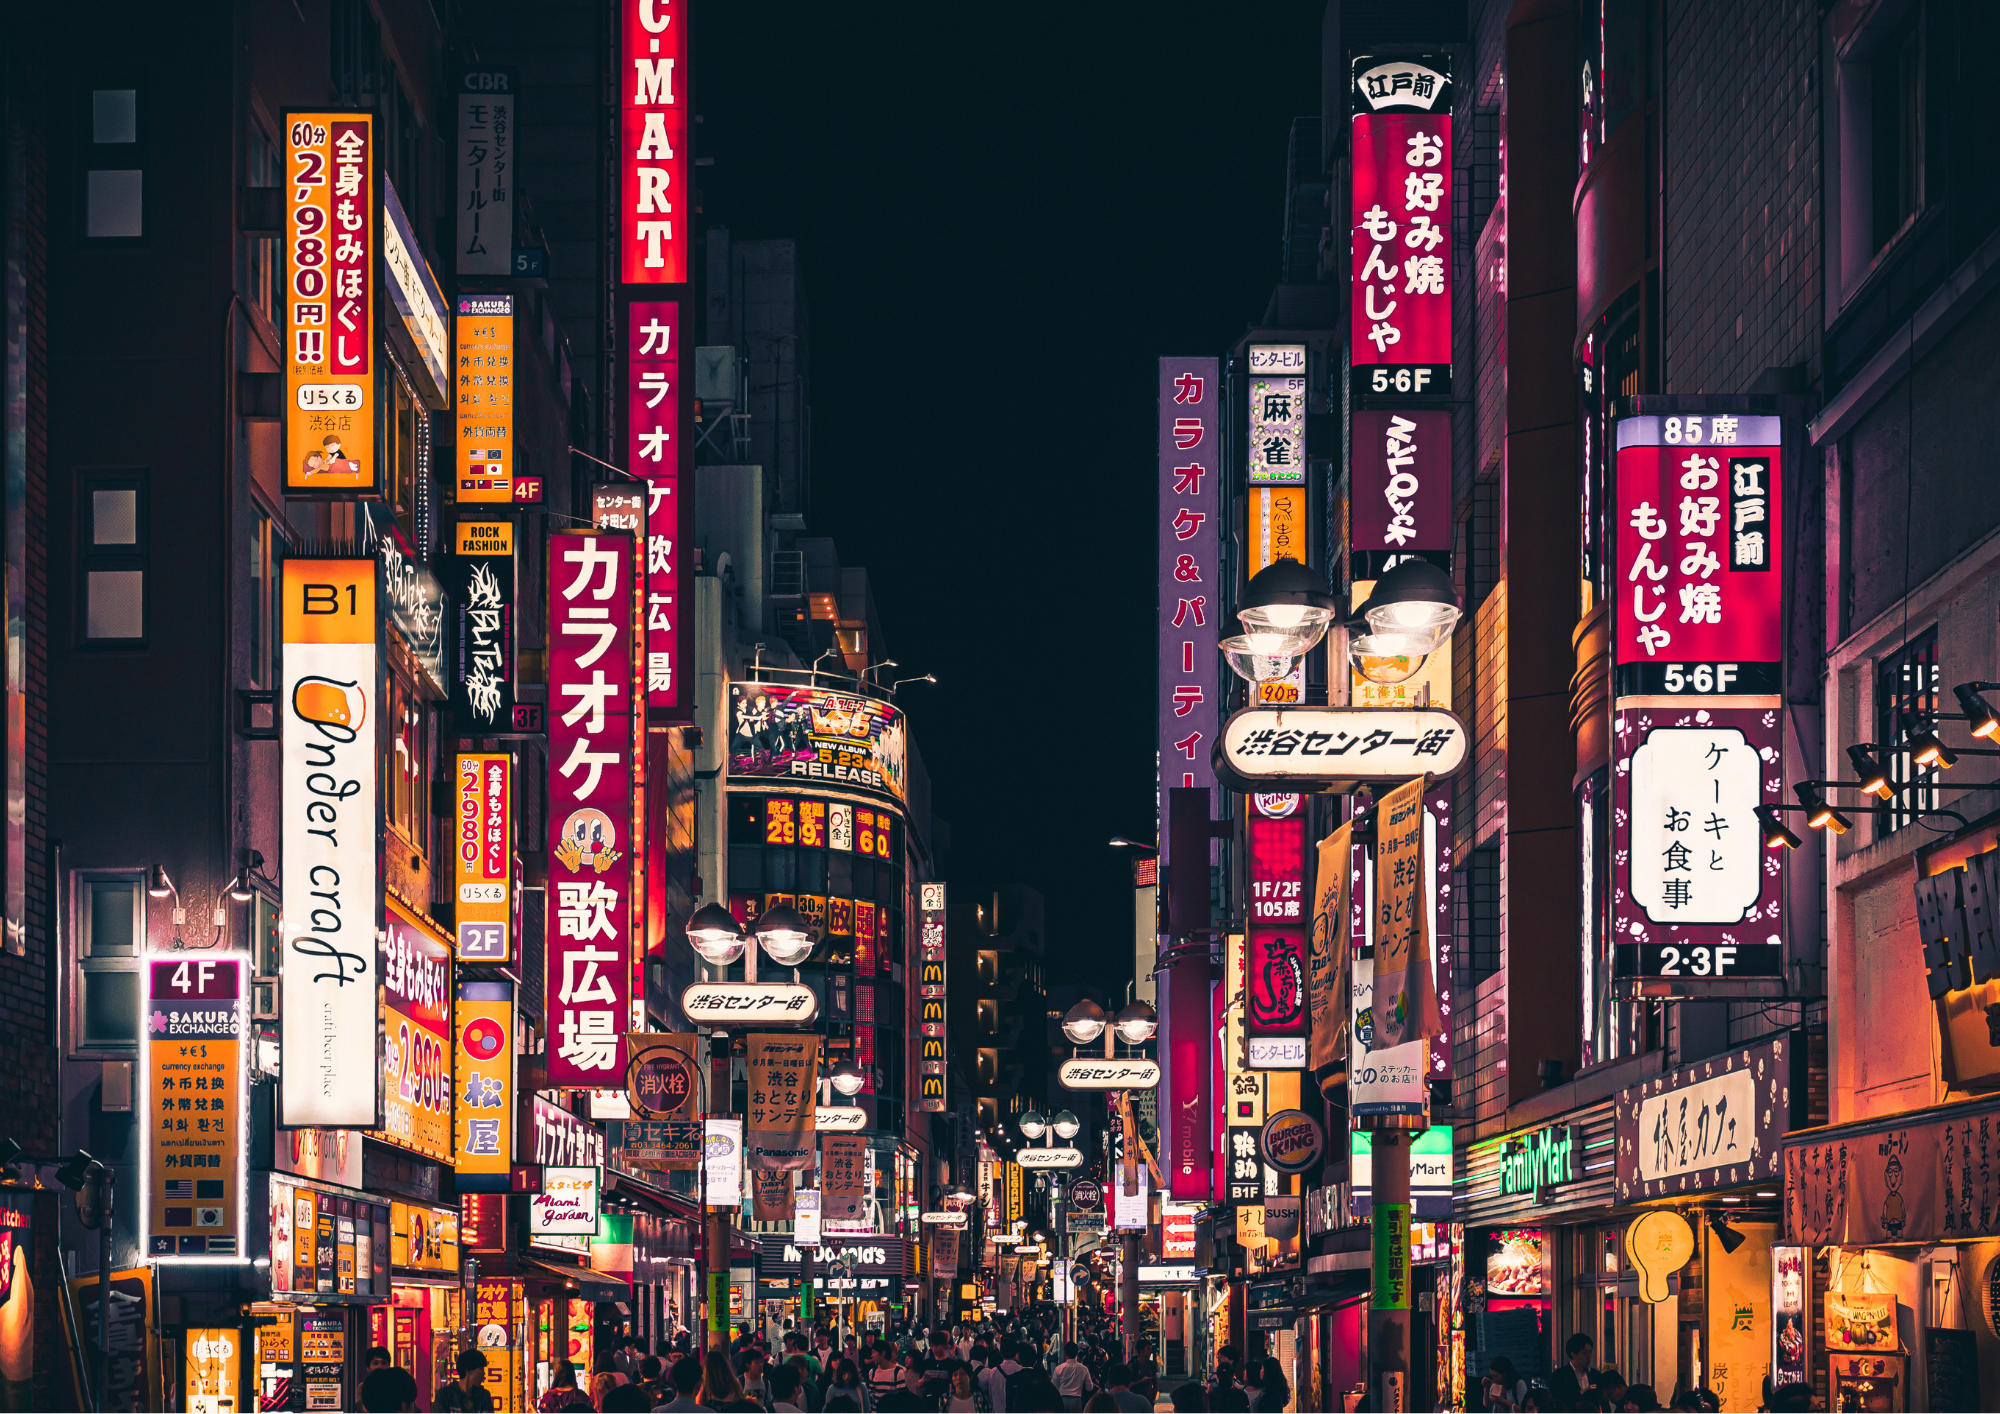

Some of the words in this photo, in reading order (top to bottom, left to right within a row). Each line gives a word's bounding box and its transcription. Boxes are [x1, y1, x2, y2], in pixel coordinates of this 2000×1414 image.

[464, 72, 508, 90] CBR
[1366, 73, 1435, 98] 江戸前
[492, 105, 507, 202] 渋谷センター街
[466, 105, 488, 255] モニタールーム
[1403, 131, 1445, 295] お好み焼
[334, 129, 365, 366] 全身もみほぐし
[1360, 205, 1401, 353] もんじゃ
[471, 301, 510, 312] SAKURA
[1251, 351, 1303, 367] センタービル
[1289, 379, 1304, 390] 5F
[303, 391, 361, 406] りらくる
[309, 415, 351, 431] 渋谷店
[463, 426, 507, 437] 外貨両替
[1263, 394, 1291, 465] 麻雀
[1664, 415, 1738, 444] 85席
[515, 483, 539, 498] 4F
[597, 495, 641, 510] センター街
[1733, 462, 1764, 565] 江戸前
[471, 526, 499, 537] ROCK
[1679, 453, 1721, 624] お好み焼
[463, 540, 507, 551] FASHION
[1628, 501, 1671, 656] もんじゃ
[303, 584, 357, 615] B1
[1362, 686, 1406, 698] 北海道
[517, 708, 538, 727] 3F
[815, 742, 837, 751] NEW
[838, 744, 867, 755] ALBUM
[1236, 729, 1455, 756] 渋谷センター街
[819, 749, 863, 768] 5.23
[791, 761, 882, 787] RELEASE
[558, 537, 620, 1071] カラオケ歌広場
[1704, 742, 1729, 871] ケーキと
[488, 765, 502, 874] 全身もみほぐし
[1662, 806, 1693, 910] お食事
[464, 888, 501, 899] りらくる
[1255, 901, 1300, 917] 105席
[292, 863, 367, 987] craft
[467, 930, 499, 951] 2F
[171, 961, 216, 993] 4F
[386, 924, 448, 1022] 全身もみほぐし
[689, 995, 809, 1010] 渋谷センター街
[169, 1011, 240, 1023] SAKURA
[169, 1023, 229, 1034] EXCHANGE
[323, 1034, 337, 1062] beer
[1251, 1044, 1304, 1058] センタービル
[161, 1063, 191, 1072] currency
[193, 1063, 225, 1071] exchange
[400, 1020, 451, 1115] 2,980円
[752, 1058, 812, 1067] 6月第一日曜日は
[1380, 1065, 1417, 1074] ステッカー
[319, 1065, 337, 1097] place
[767, 1071, 799, 1087] 渋谷
[1066, 1068, 1156, 1079] 渋谷センター街
[640, 1073, 685, 1095] 消火栓
[1233, 1075, 1259, 1096] 鍋
[753, 1090, 811, 1105] おとなり
[463, 1072, 504, 1155] 松屋
[752, 1109, 812, 1124] サンデー
[1270, 1123, 1312, 1145] BURGER
[535, 1107, 605, 1190] カラオケ歌広場
[756, 1147, 808, 1157] Panasonic
[1272, 1134, 1315, 1159] KING
[165, 1155, 221, 1168] 外貨両替
[834, 1159, 854, 1168] 渋谷
[1499, 1124, 1573, 1204] FamilyMart
[825, 1170, 862, 1180] おとなり
[825, 1181, 862, 1191] サンデー
[1232, 1186, 1259, 1199] B1F
[533, 1194, 581, 1207] Miami
[1266, 1209, 1299, 1219] SUSHI
